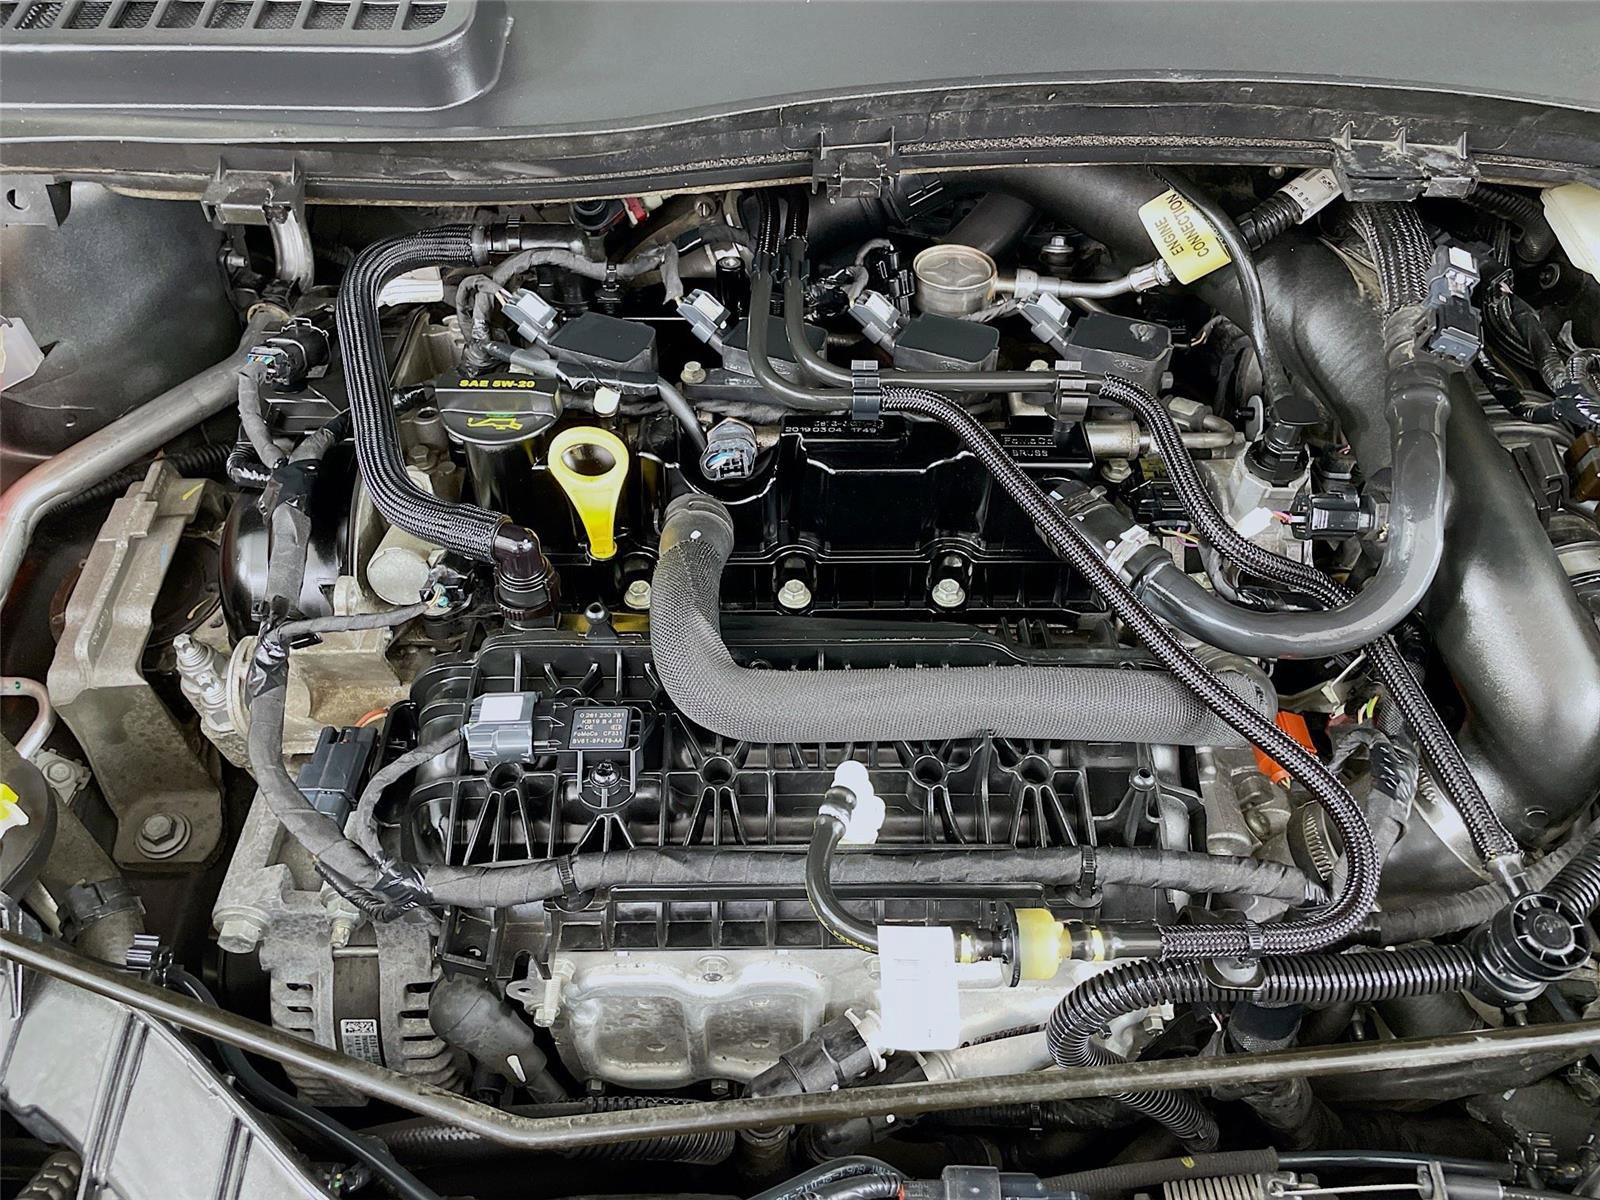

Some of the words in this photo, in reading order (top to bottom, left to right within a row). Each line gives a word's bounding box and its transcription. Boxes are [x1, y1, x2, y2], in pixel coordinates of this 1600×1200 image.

[1154, 217, 1184, 256] ENGINE
[1166, 193, 1209, 258] CONNECTION
[459, 379, 489, 388] SAE
[492, 380, 536, 388] 5W-20
